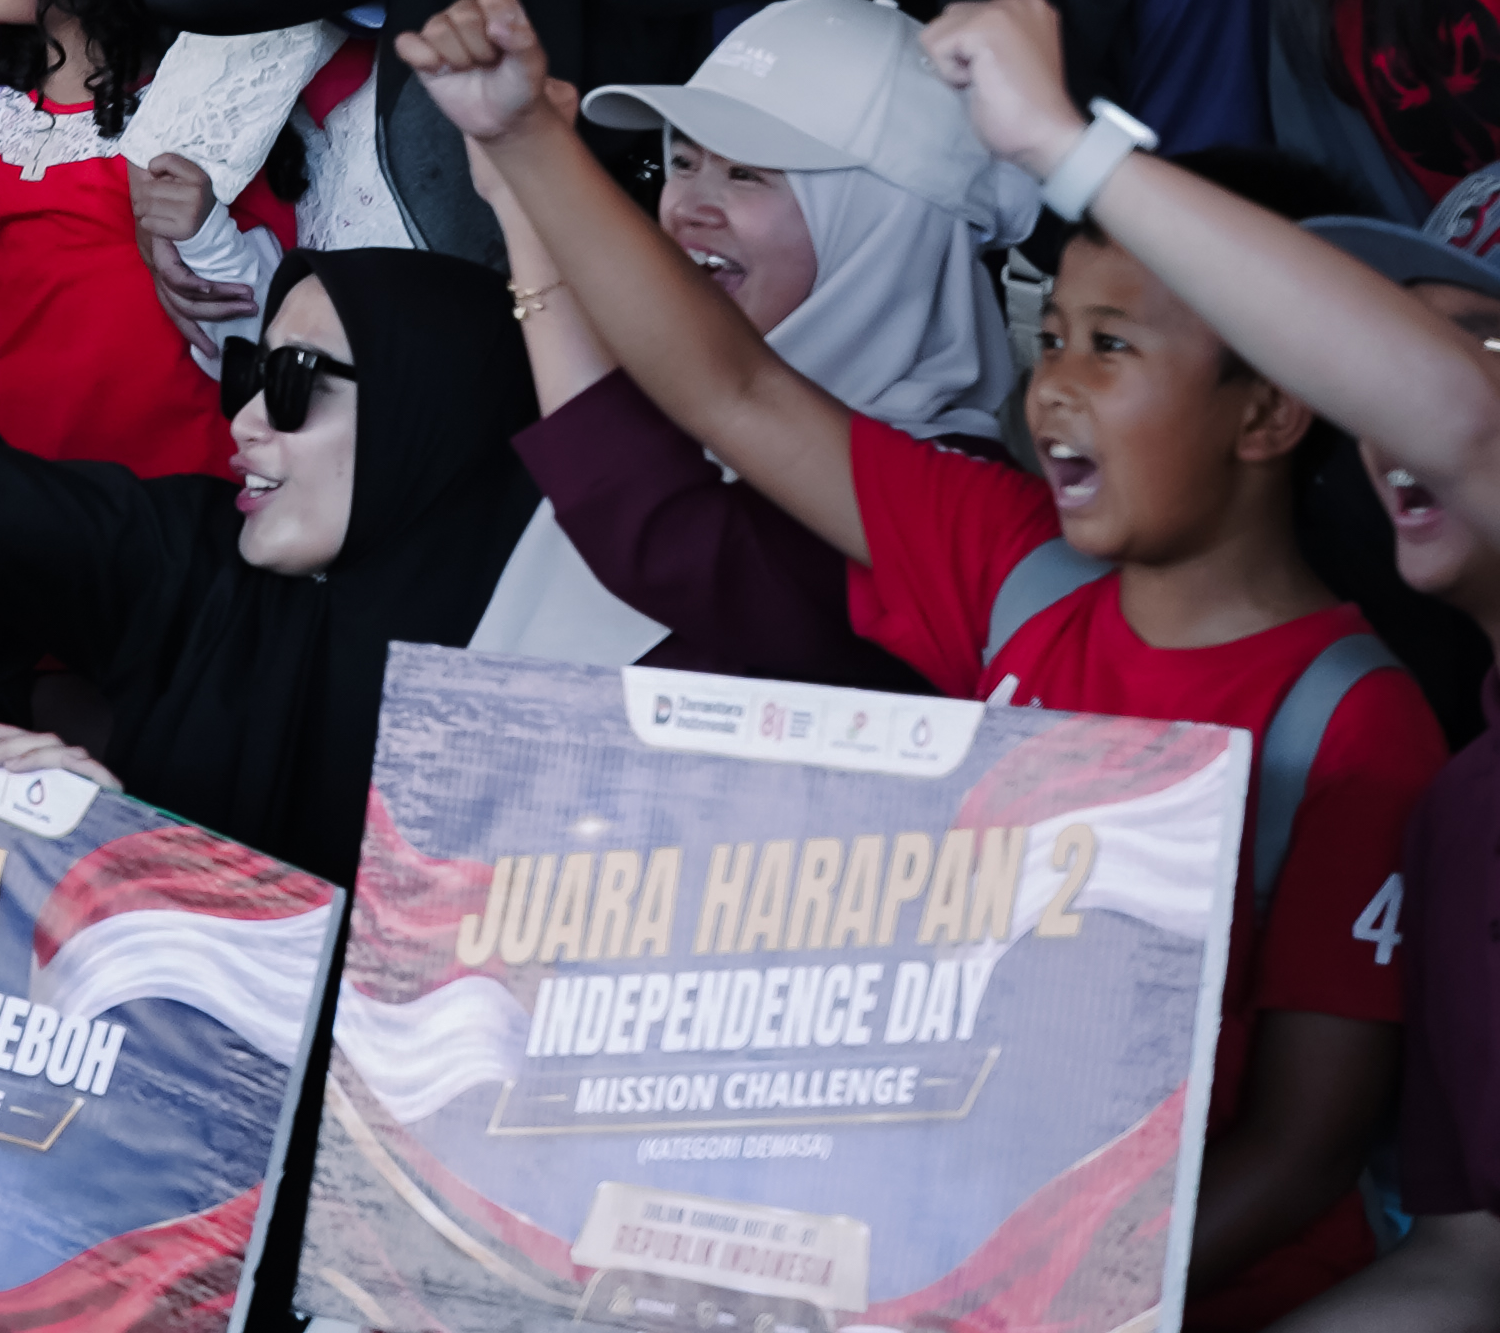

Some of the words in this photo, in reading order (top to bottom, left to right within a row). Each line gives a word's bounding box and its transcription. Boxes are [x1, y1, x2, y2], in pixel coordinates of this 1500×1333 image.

[457, 845, 683, 967] JUARA
[692, 826, 1032, 957] HARAPAN
[1036, 822, 1096, 939] 2
[1351, 872, 1404, 965] 4
[525, 963, 877, 1059] INDEPENDENCE
[885, 956, 995, 1044] DAY
[574, 1073, 715, 1115] MISSION
[722, 1066, 917, 1111] CHALLENGE
